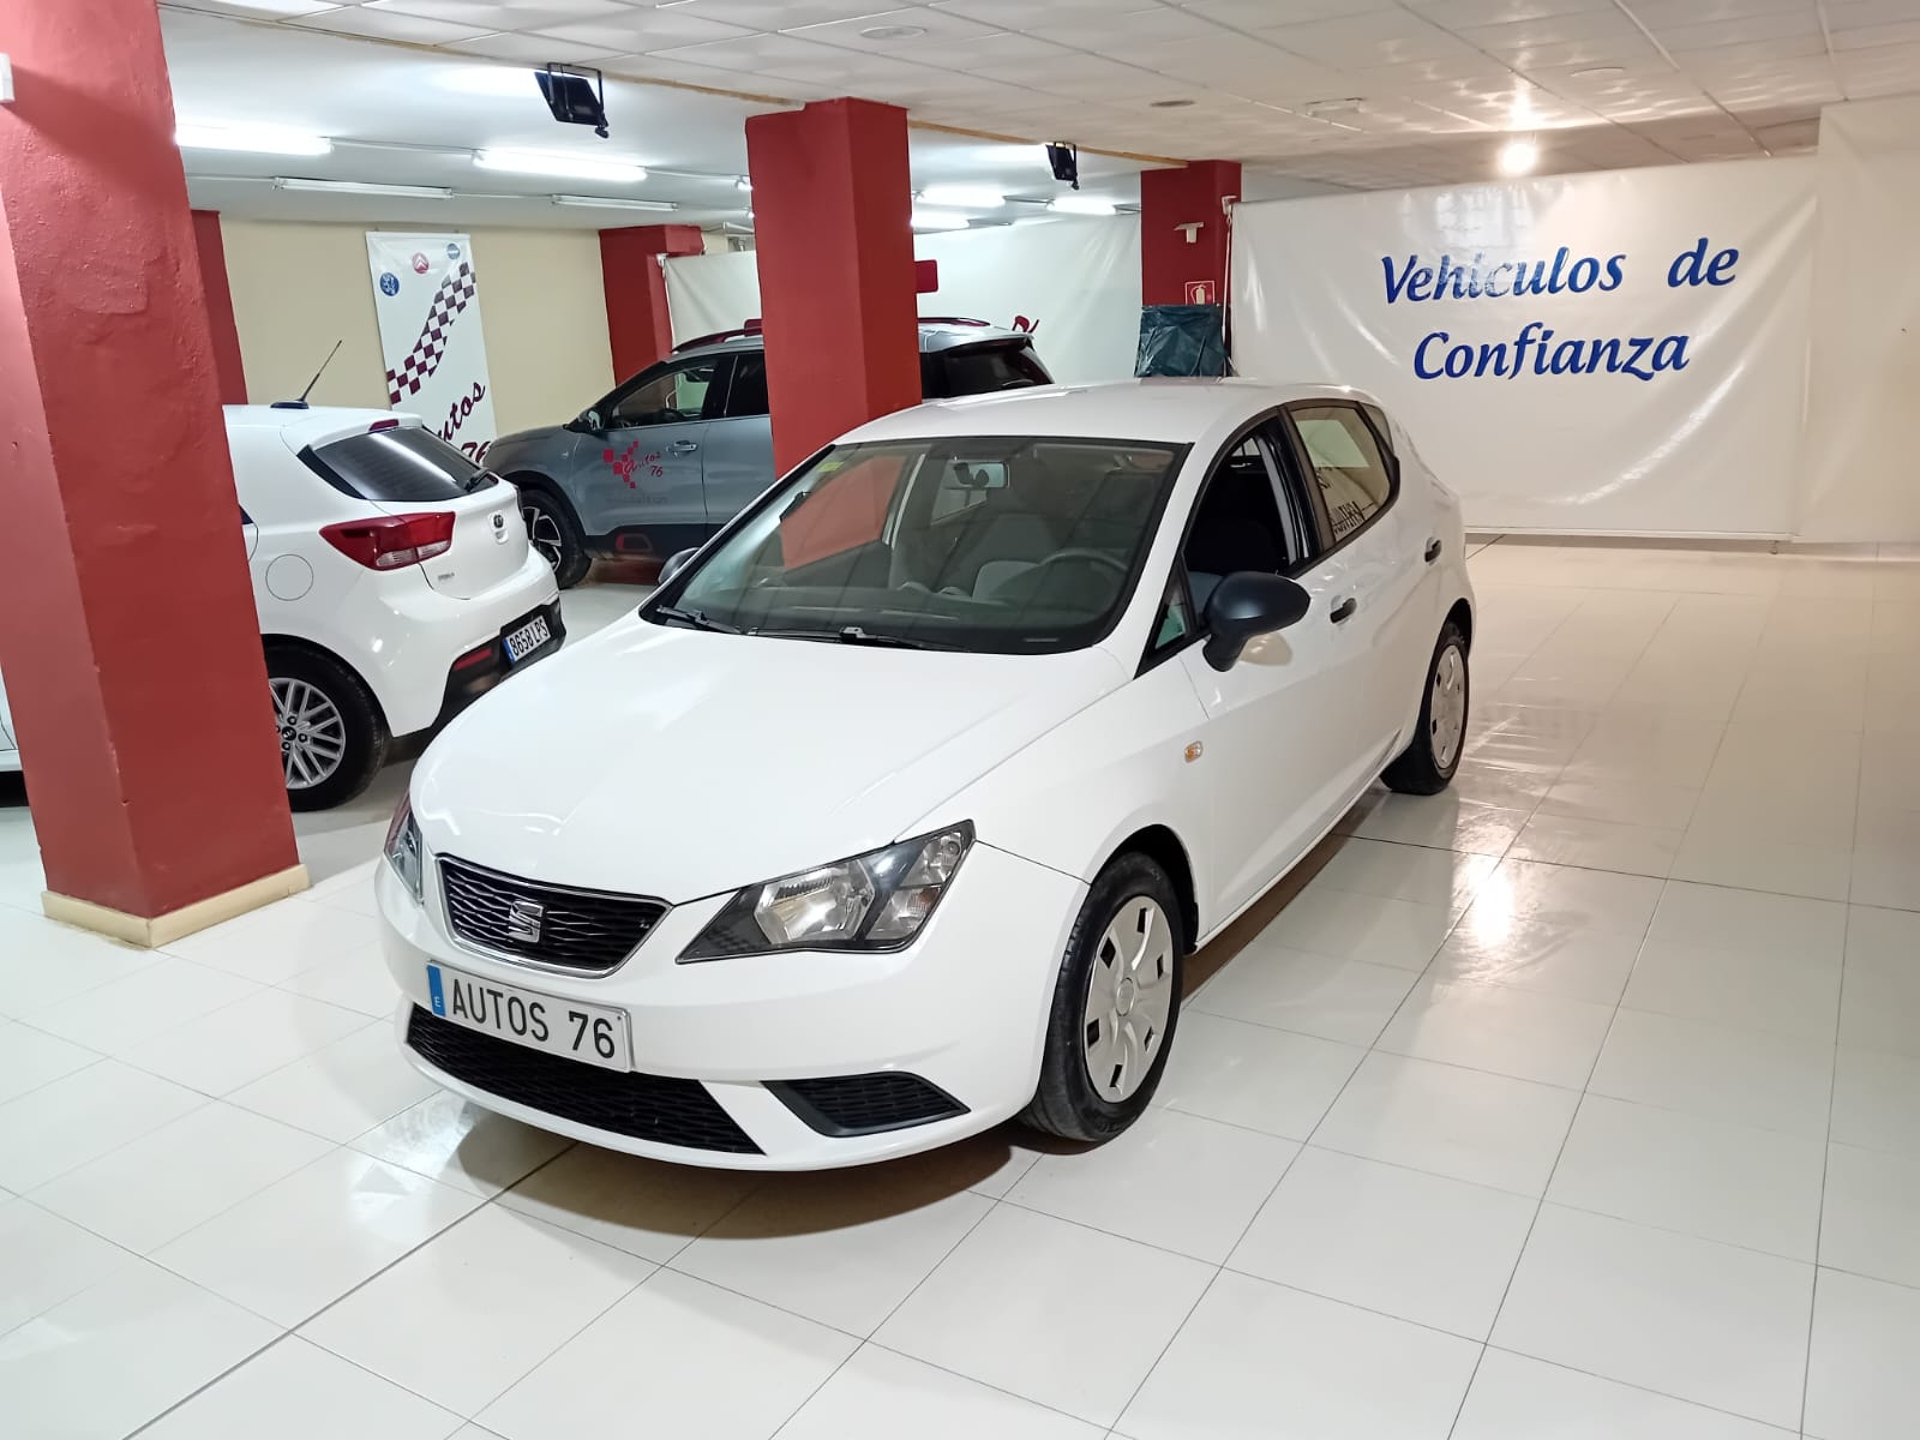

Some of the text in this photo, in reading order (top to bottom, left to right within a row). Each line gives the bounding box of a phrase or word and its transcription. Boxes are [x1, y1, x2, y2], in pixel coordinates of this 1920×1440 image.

[1667, 237, 1740, 287] de
[1414, 322, 1690, 381] Confianza
[650, 465, 663, 478] 76
[510, 619, 548, 656] 8658 LPS
[453, 979, 615, 1059] AUTOS 76
